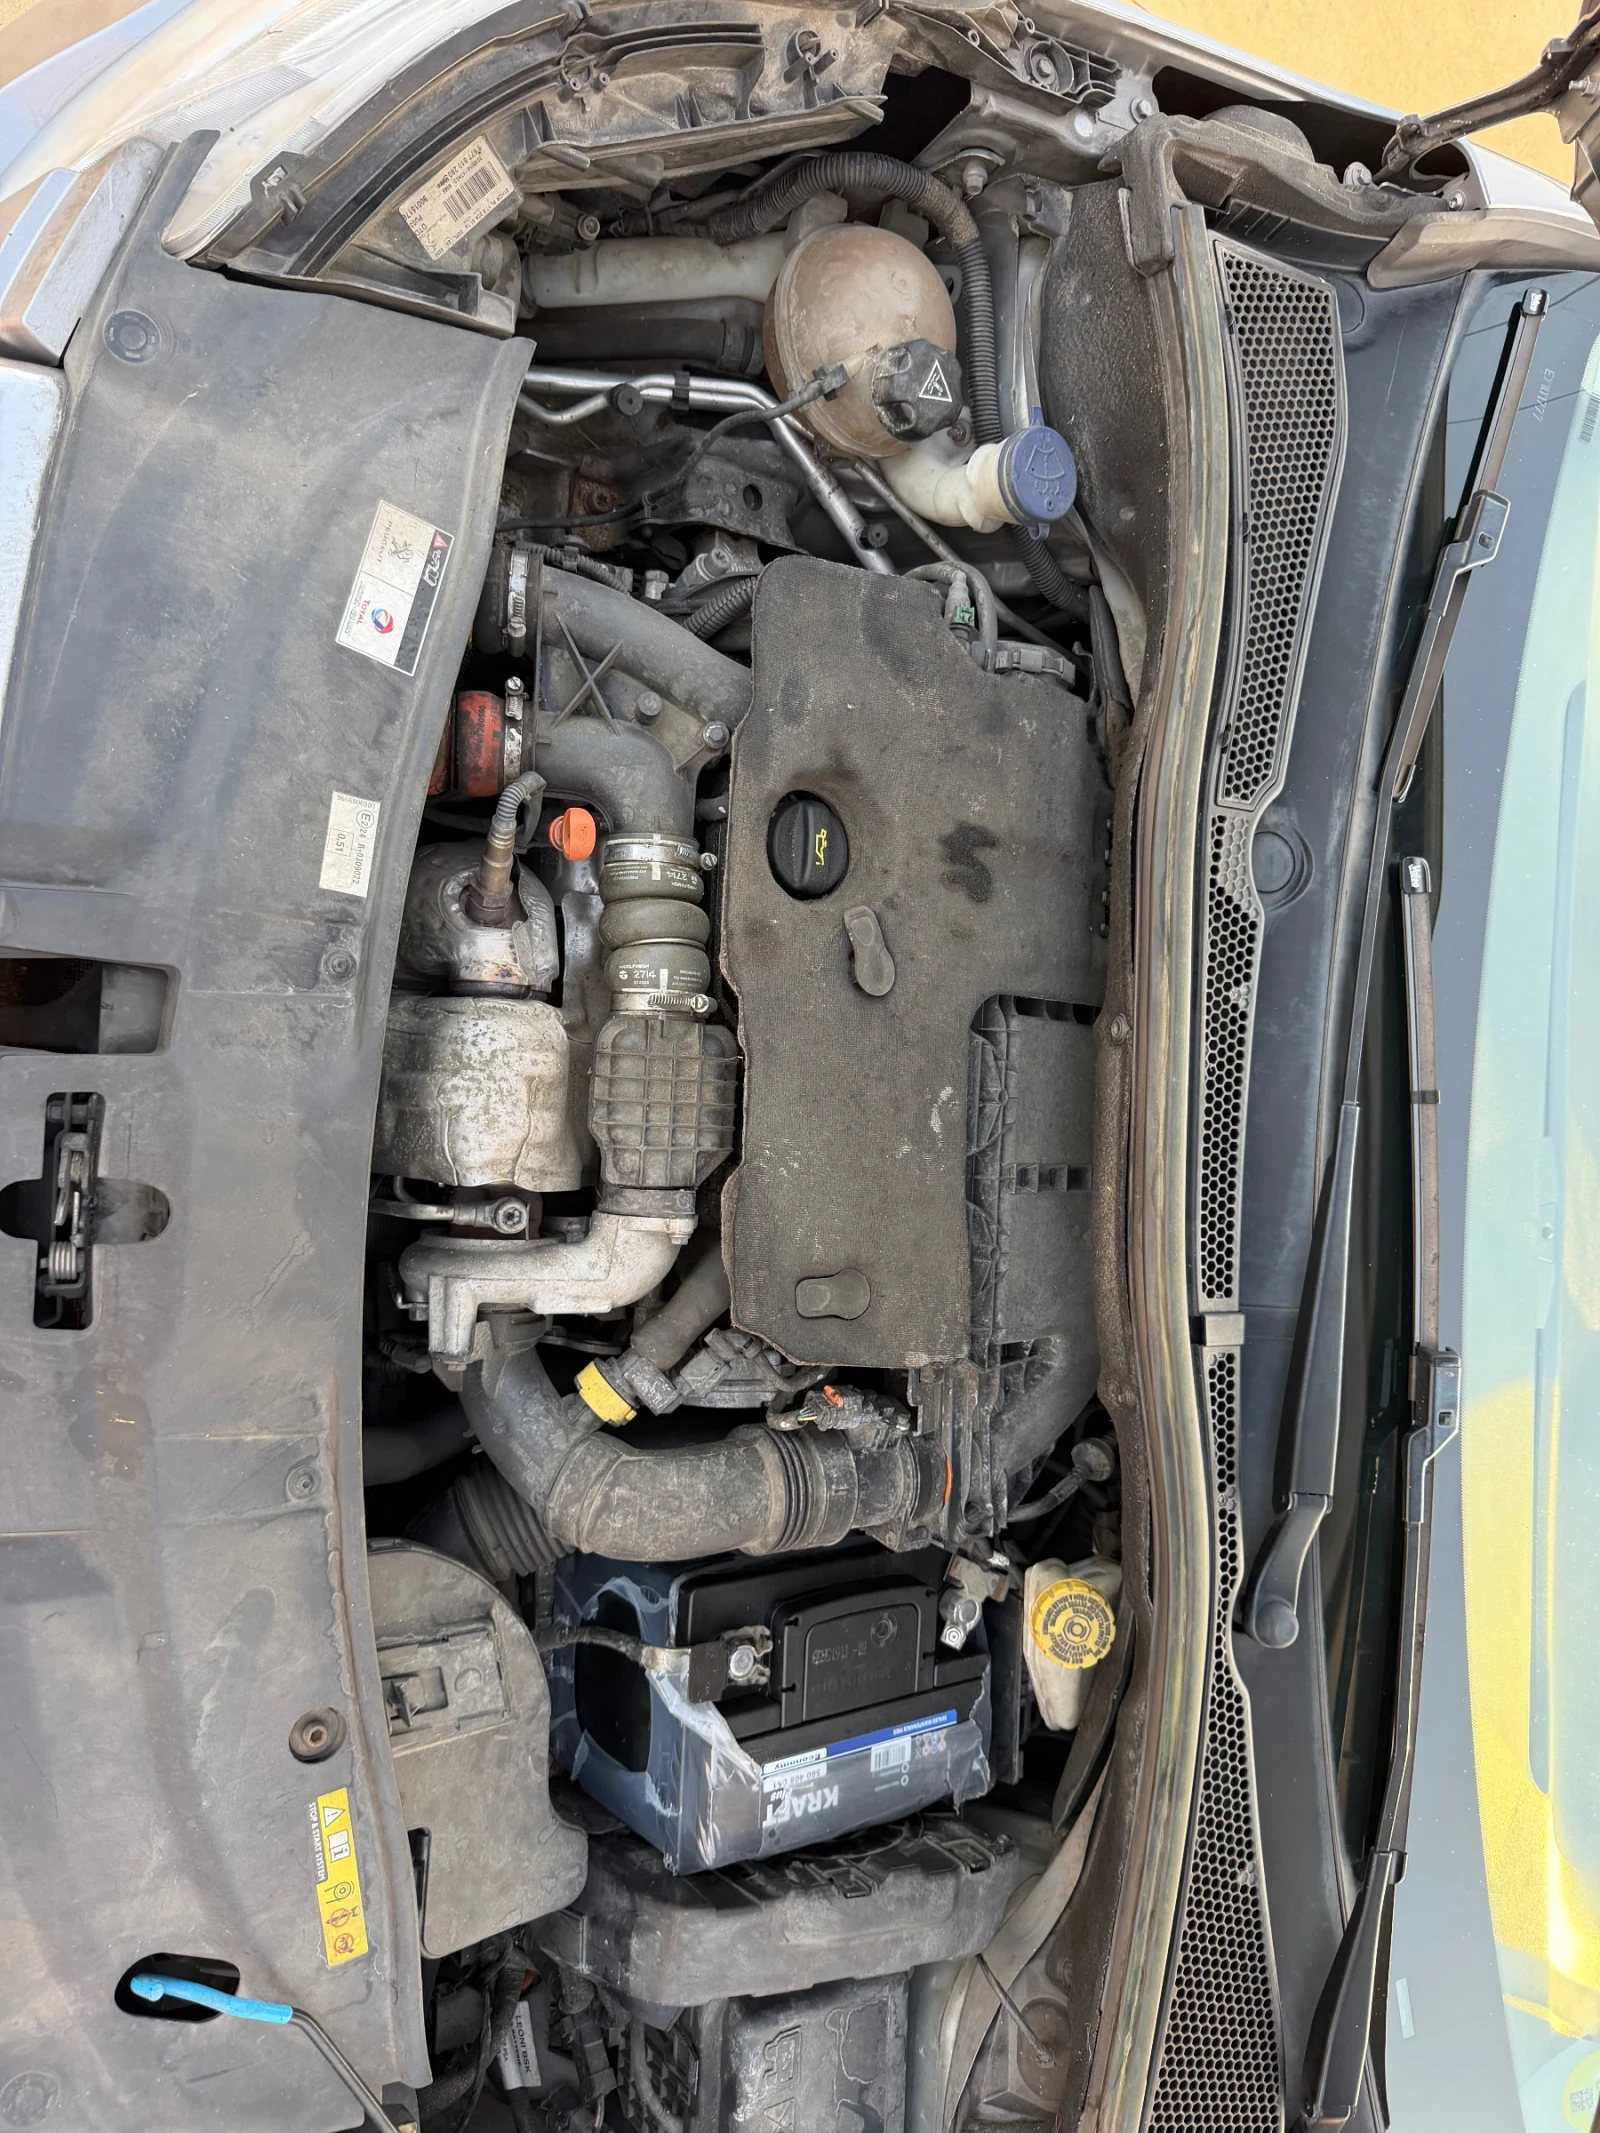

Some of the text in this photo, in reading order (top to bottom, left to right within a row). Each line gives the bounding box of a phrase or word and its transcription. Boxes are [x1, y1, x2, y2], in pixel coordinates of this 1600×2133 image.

[377, 521, 393, 563] PEUGEOT
[666, 871, 686, 880] 2714
[632, 969, 656, 978] 2714
[774, 1753, 821, 1769] Economy
[307, 1801, 318, 1822] STOP
[763, 1785, 838, 1827] KRAFT
[311, 1828, 322, 1851] START
[314, 1852, 326, 1881] SYSTEM
[515, 2015, 531, 2073] LEONI BSK
